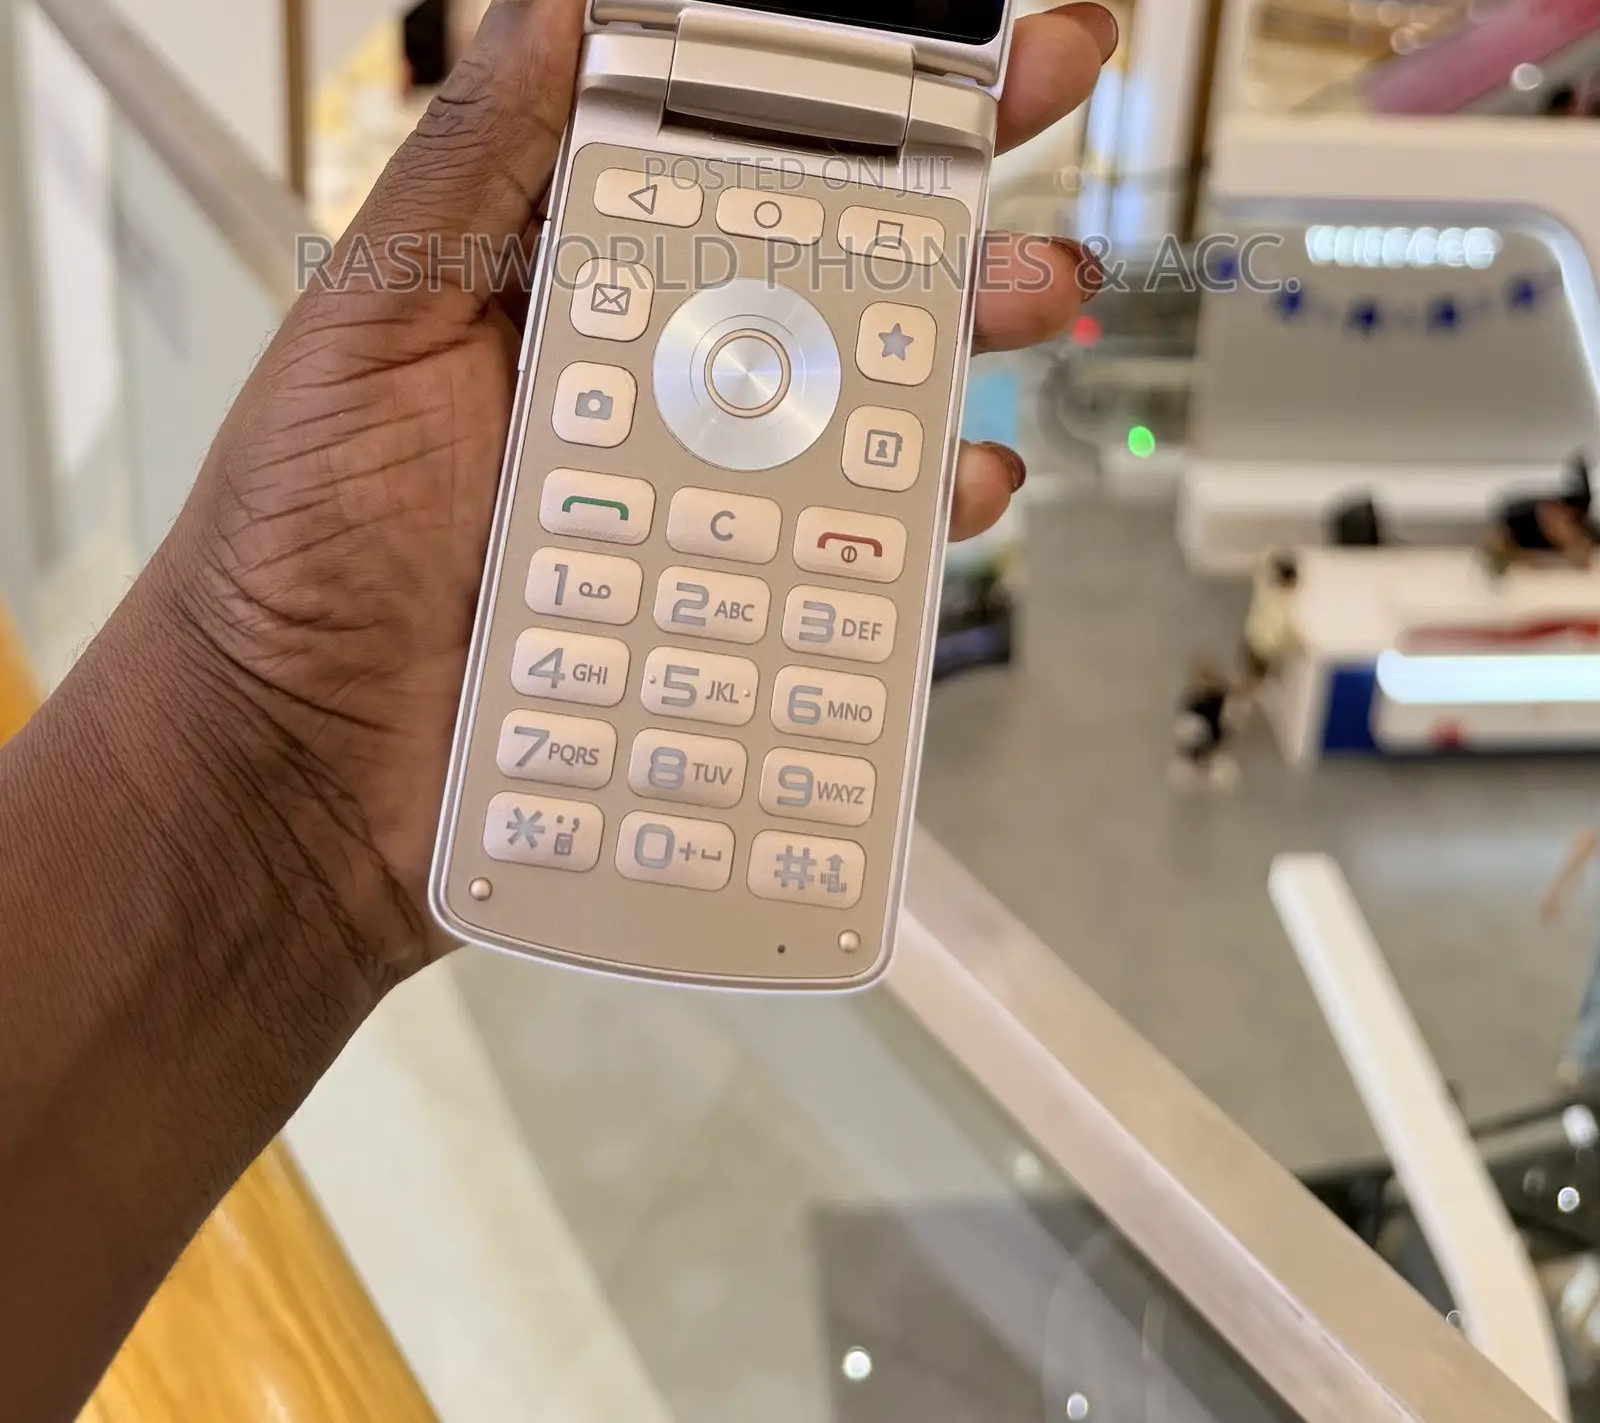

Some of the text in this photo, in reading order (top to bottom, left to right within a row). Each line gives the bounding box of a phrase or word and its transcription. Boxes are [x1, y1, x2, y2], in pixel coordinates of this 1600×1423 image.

[710, 510, 736, 542] C
[553, 563, 568, 605] 1
[671, 582, 755, 626] 2 ABC
[799, 599, 883, 644] 3 DEF
[527, 647, 608, 689] 4 GHI
[660, 664, 740, 708] 5 JKL
[787, 684, 873, 725] 6 MNO
[514, 726, 600, 768] 7 PQRS
[648, 746, 733, 791] 8 TUV
[777, 765, 866, 808] 9 WXYZ
[634, 823, 675, 869] 0
[774, 845, 817, 890] #
